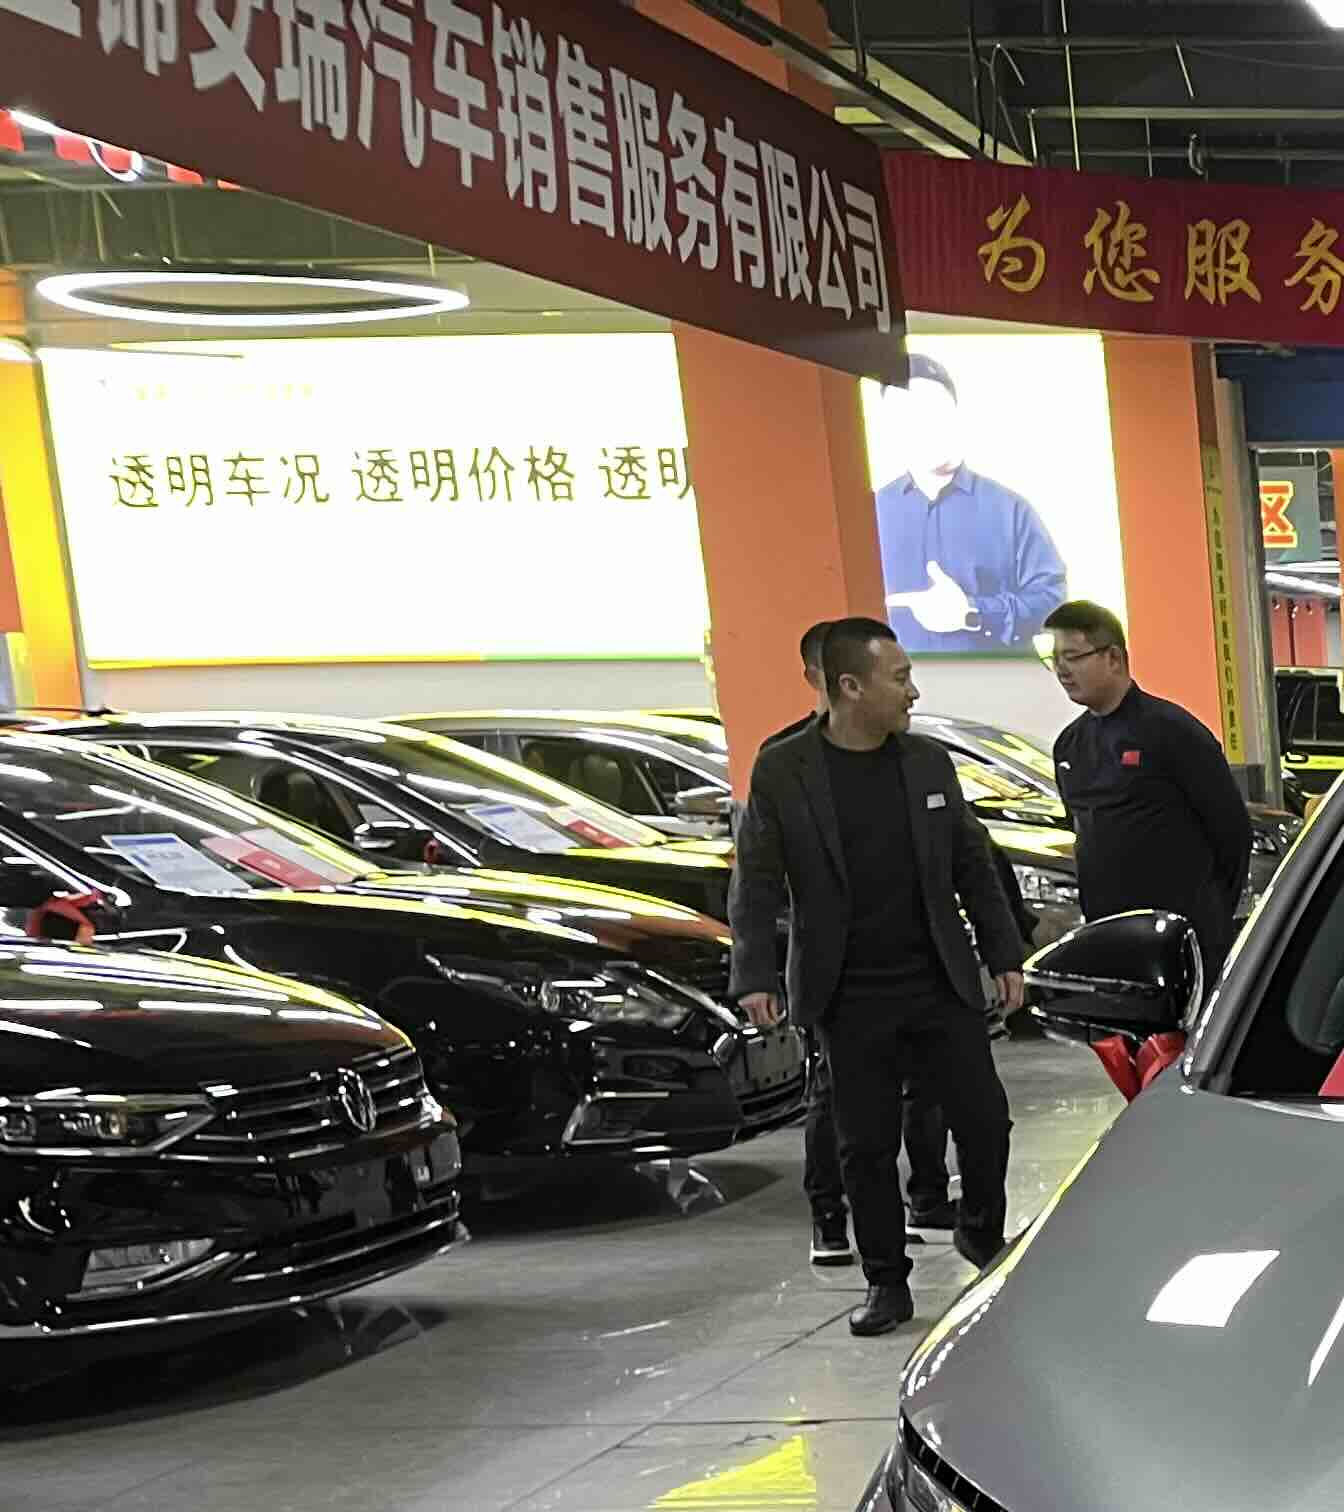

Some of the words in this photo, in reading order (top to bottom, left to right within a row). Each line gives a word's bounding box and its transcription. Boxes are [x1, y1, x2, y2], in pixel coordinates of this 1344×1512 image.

[0, 0, 892, 334] 瑞汽车销售服务有限公司
[108, 450, 331, 509] 透明车况
[351, 445, 578, 505] 透明价格
